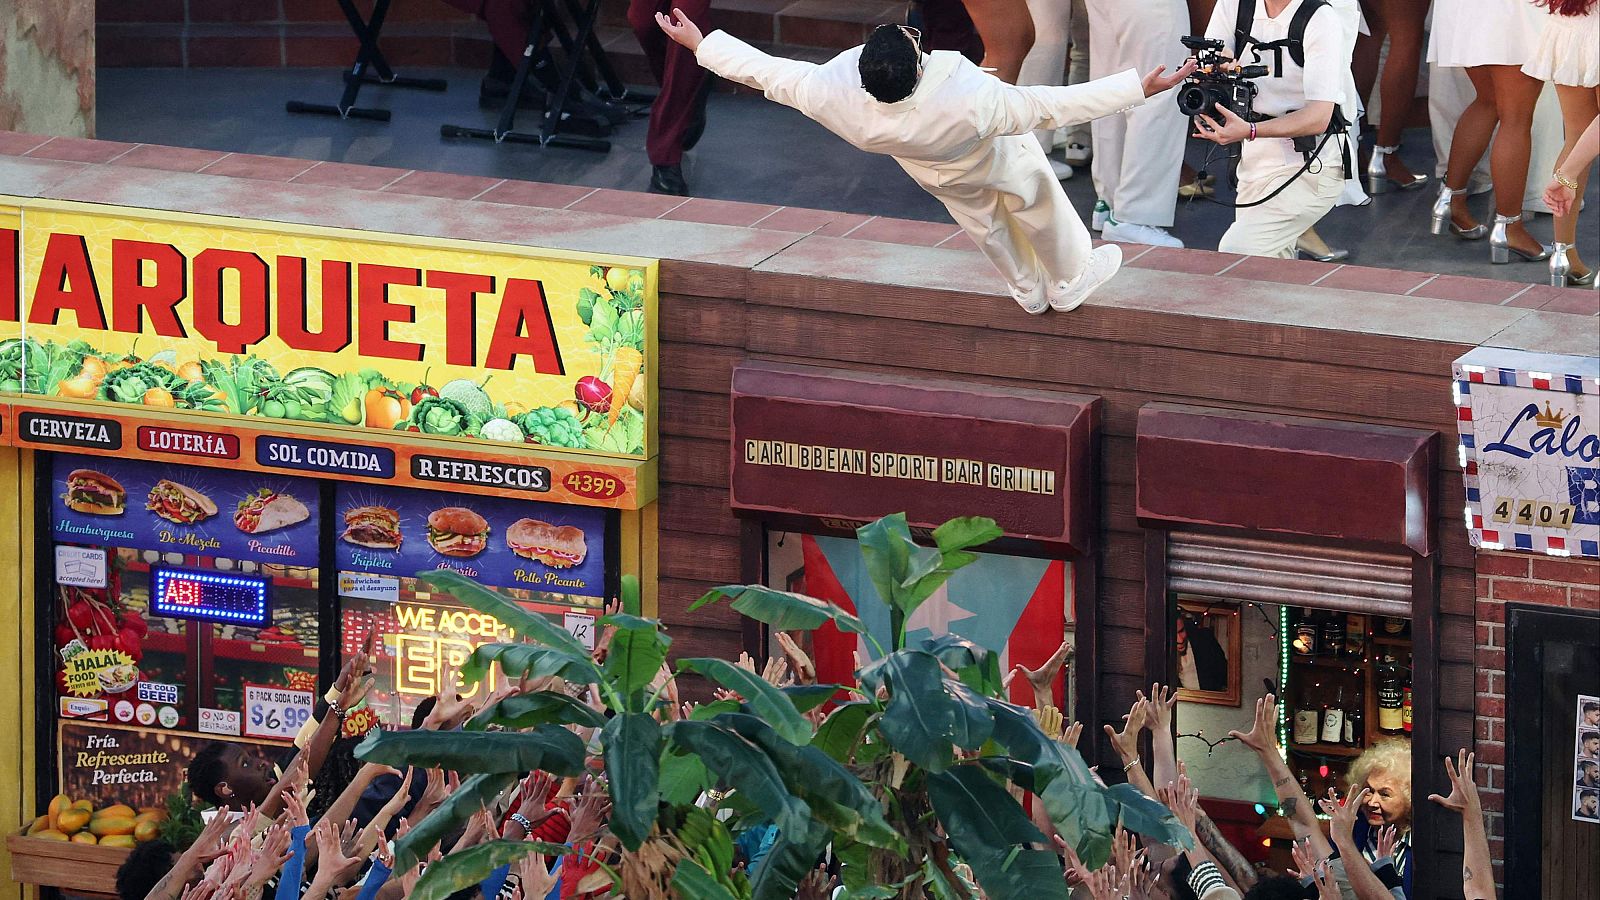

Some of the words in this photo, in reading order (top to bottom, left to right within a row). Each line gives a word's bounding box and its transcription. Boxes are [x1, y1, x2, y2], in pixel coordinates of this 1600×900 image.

[29, 418, 110, 443] CERVEZA
[149, 430, 228, 455] LOTERÍA
[269, 443, 301, 464] SOL
[306, 447, 382, 472] COMIDA
[746, 440, 865, 474] CARIBBEAN
[871, 453, 936, 480] SPORT
[946, 460, 982, 484] BAR
[989, 465, 1053, 493] GRILL
[418, 458, 543, 488] REFRESCOS
[567, 473, 616, 496] 4399
[1495, 501, 1570, 525] 4401
[56, 520, 134, 541] Hamburguesa
[159, 530, 176, 544] De
[179, 533, 220, 551] Mezcla
[248, 539, 296, 557] Picadillo
[82, 552, 103, 560] CARDS
[352, 552, 393, 571] Tripleta
[59, 575, 86, 583] accepted
[513, 569, 541, 584] Pollo
[544, 572, 586, 588] Picante
[395, 605, 436, 631] WE
[438, 610, 515, 638] ACCE
[73, 653, 122, 672] HALAL
[68, 671, 96, 683] FOOD
[139, 690, 177, 702] BEER
[154, 684, 176, 692] COLD
[249, 691, 254, 700] 6
[256, 691, 272, 702] PACK
[275, 693, 291, 704] SODA
[293, 694, 311, 706] CANS
[213, 712, 224, 721] NO
[251, 704, 309, 733] $6.99
[86, 734, 120, 749] Fría.
[75, 750, 170, 769] Refrescante.
[91, 768, 158, 785] Perfecta.
